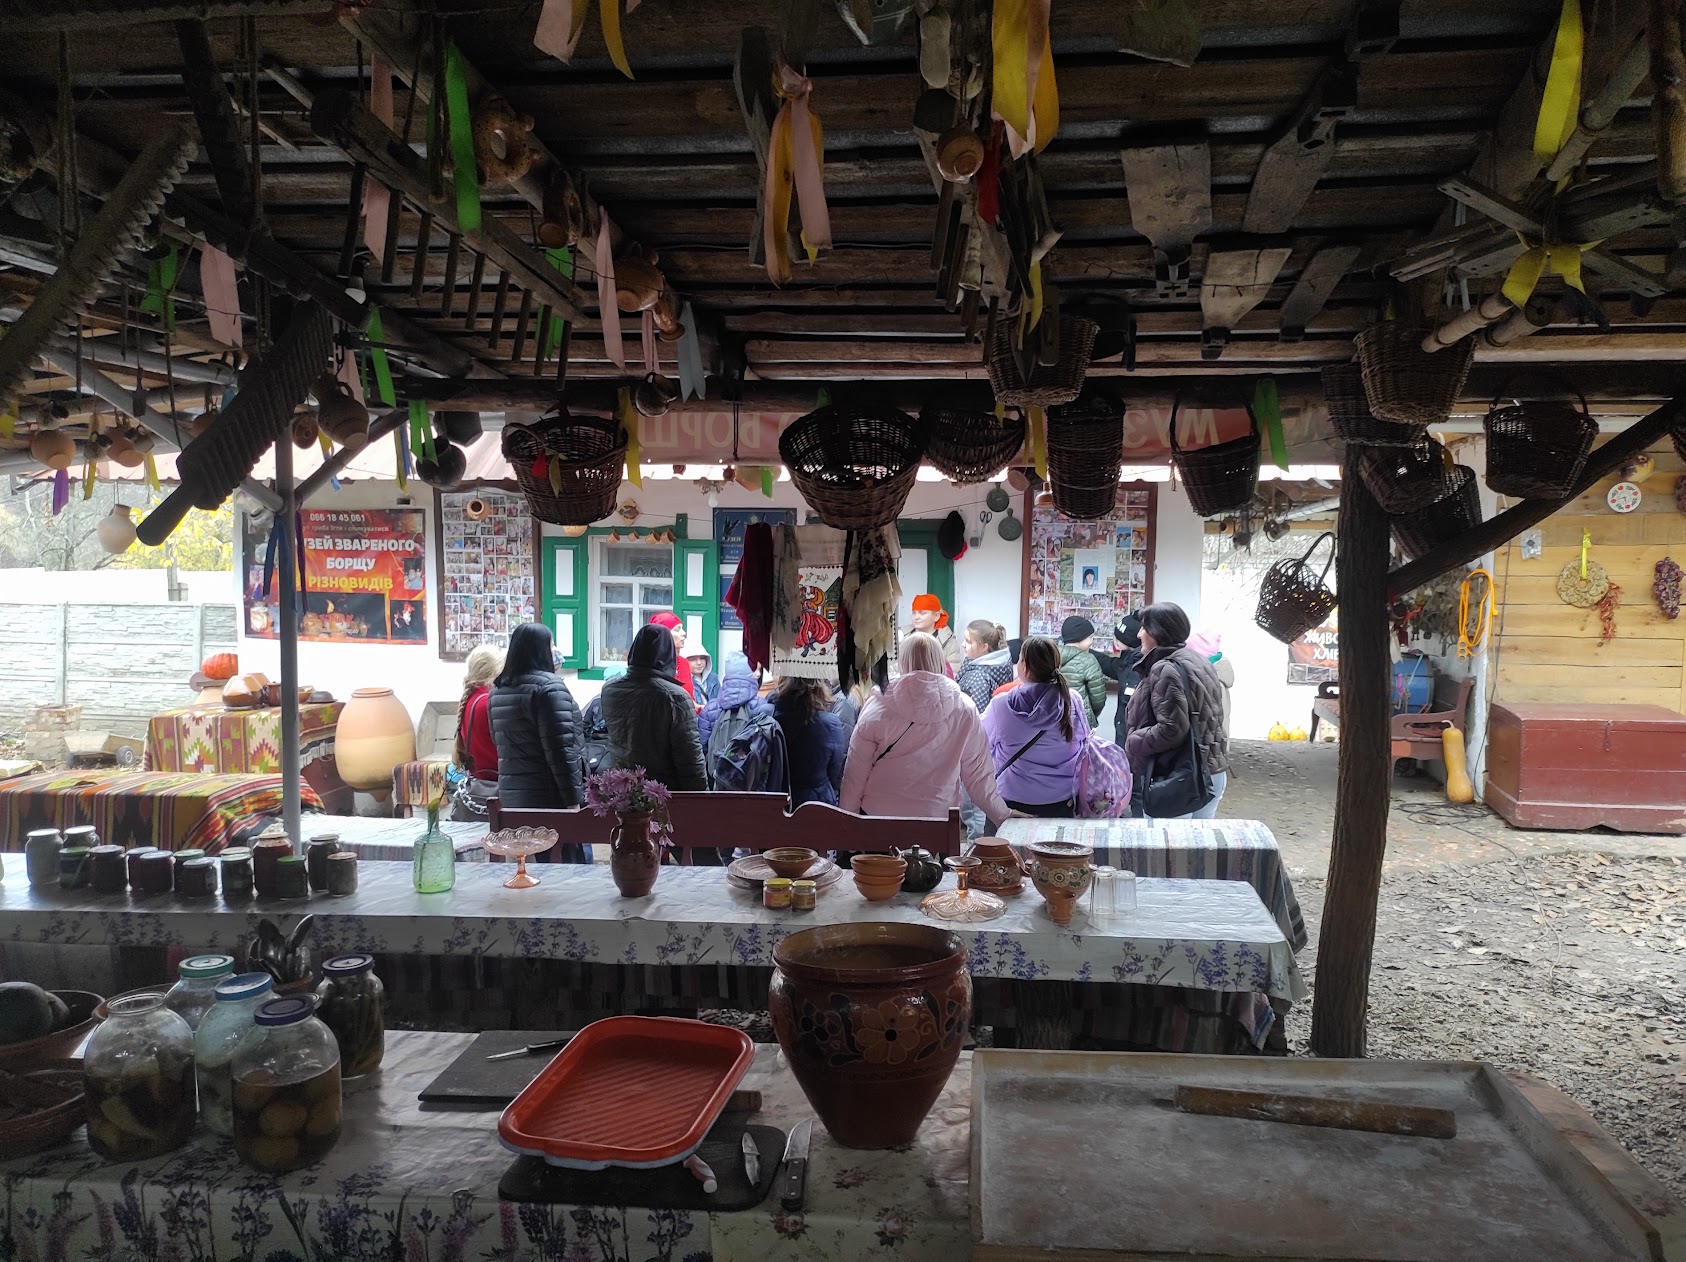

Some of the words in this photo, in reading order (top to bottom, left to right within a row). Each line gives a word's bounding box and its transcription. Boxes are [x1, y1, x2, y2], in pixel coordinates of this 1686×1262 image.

[335, 538, 415, 551] ЗВАРЕНОГО
[326, 557, 376, 571] БОРЩУ
[308, 576, 394, 590] РІЗНОВИДІВ
